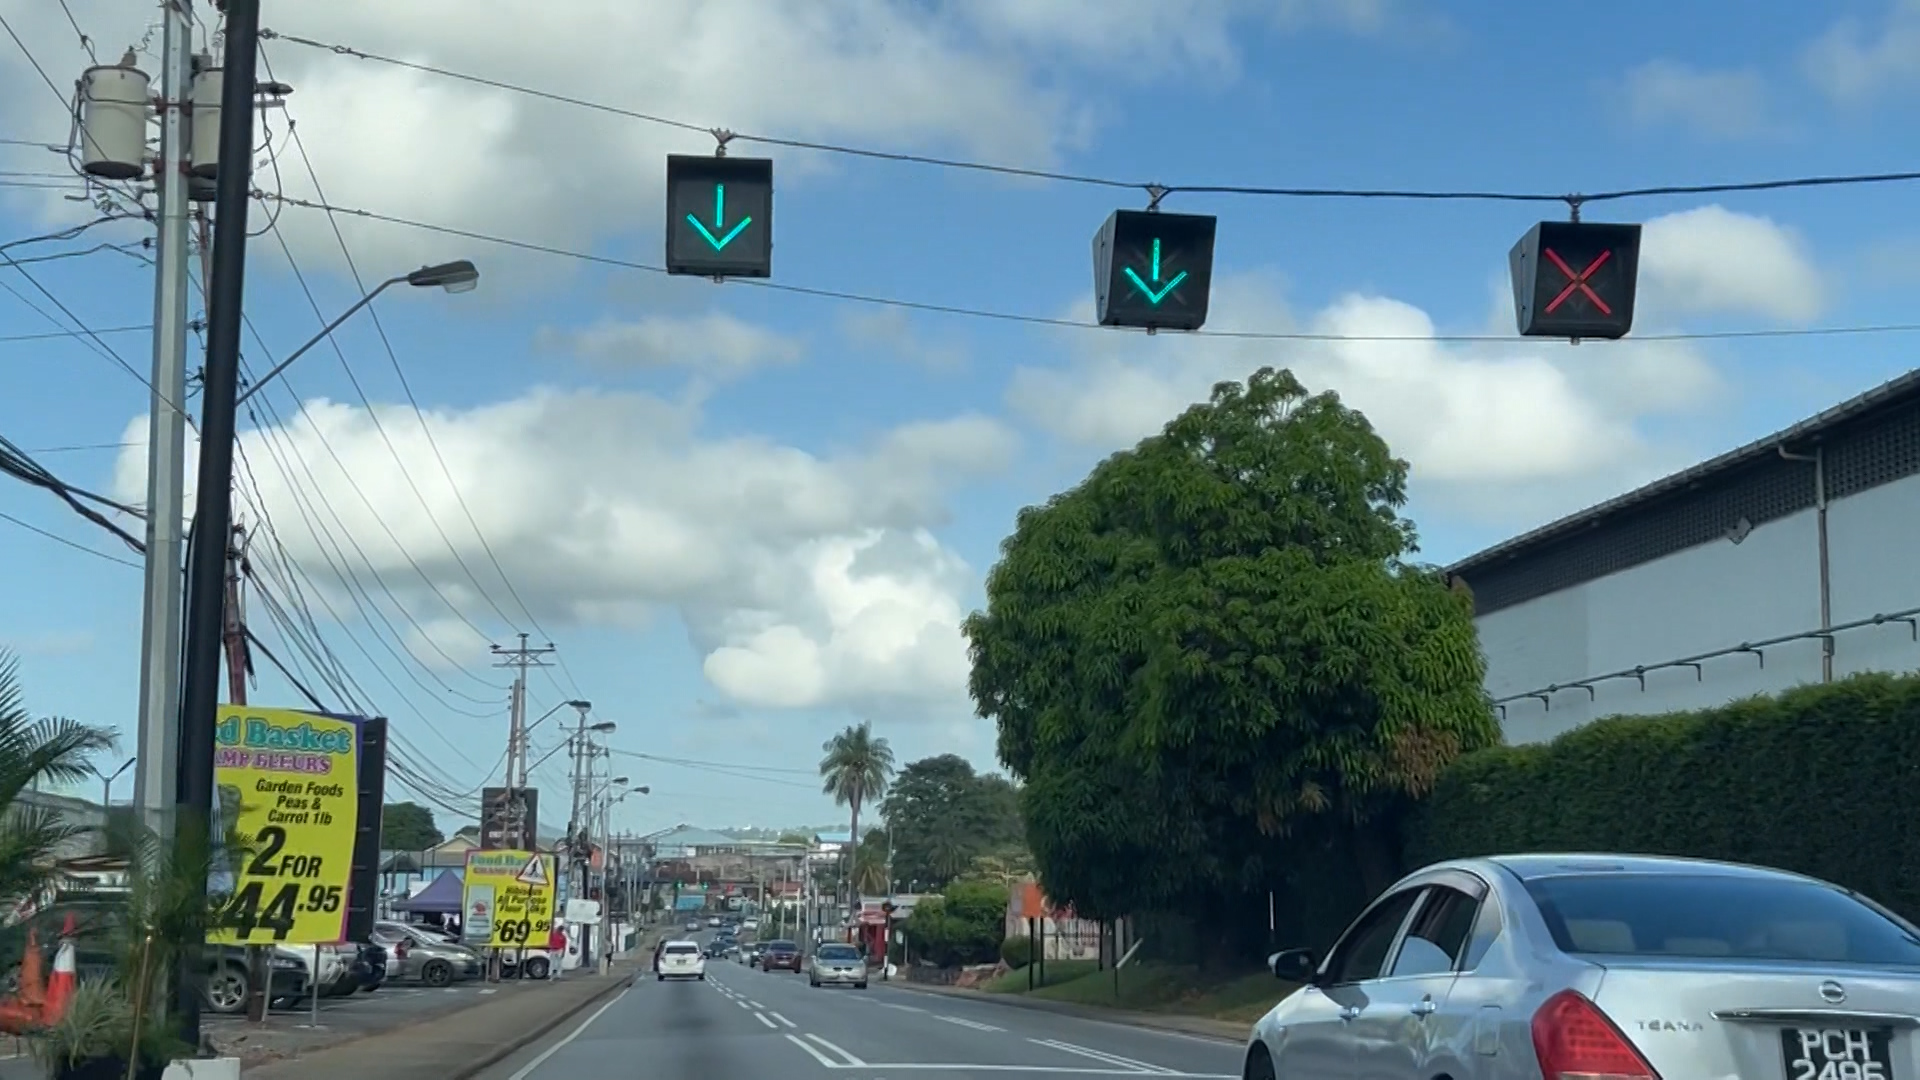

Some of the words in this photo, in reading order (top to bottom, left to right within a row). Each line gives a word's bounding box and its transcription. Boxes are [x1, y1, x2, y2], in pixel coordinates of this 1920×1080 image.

[245, 717, 352, 753] Basket
[253, 751, 331, 774] FLEURS
[256, 778, 303, 793] Garden
[306, 782, 344, 797] Foods
[276, 795, 308, 809] Peas
[311, 797, 322, 810] &
[268, 809, 309, 823] Carrot
[313, 812, 333, 826] 1lb
[247, 825, 286, 876] 2
[279, 855, 323, 878] FOR
[1637, 1020, 1703, 1031] TEANA
[1797, 1029, 1871, 1061] PCH
